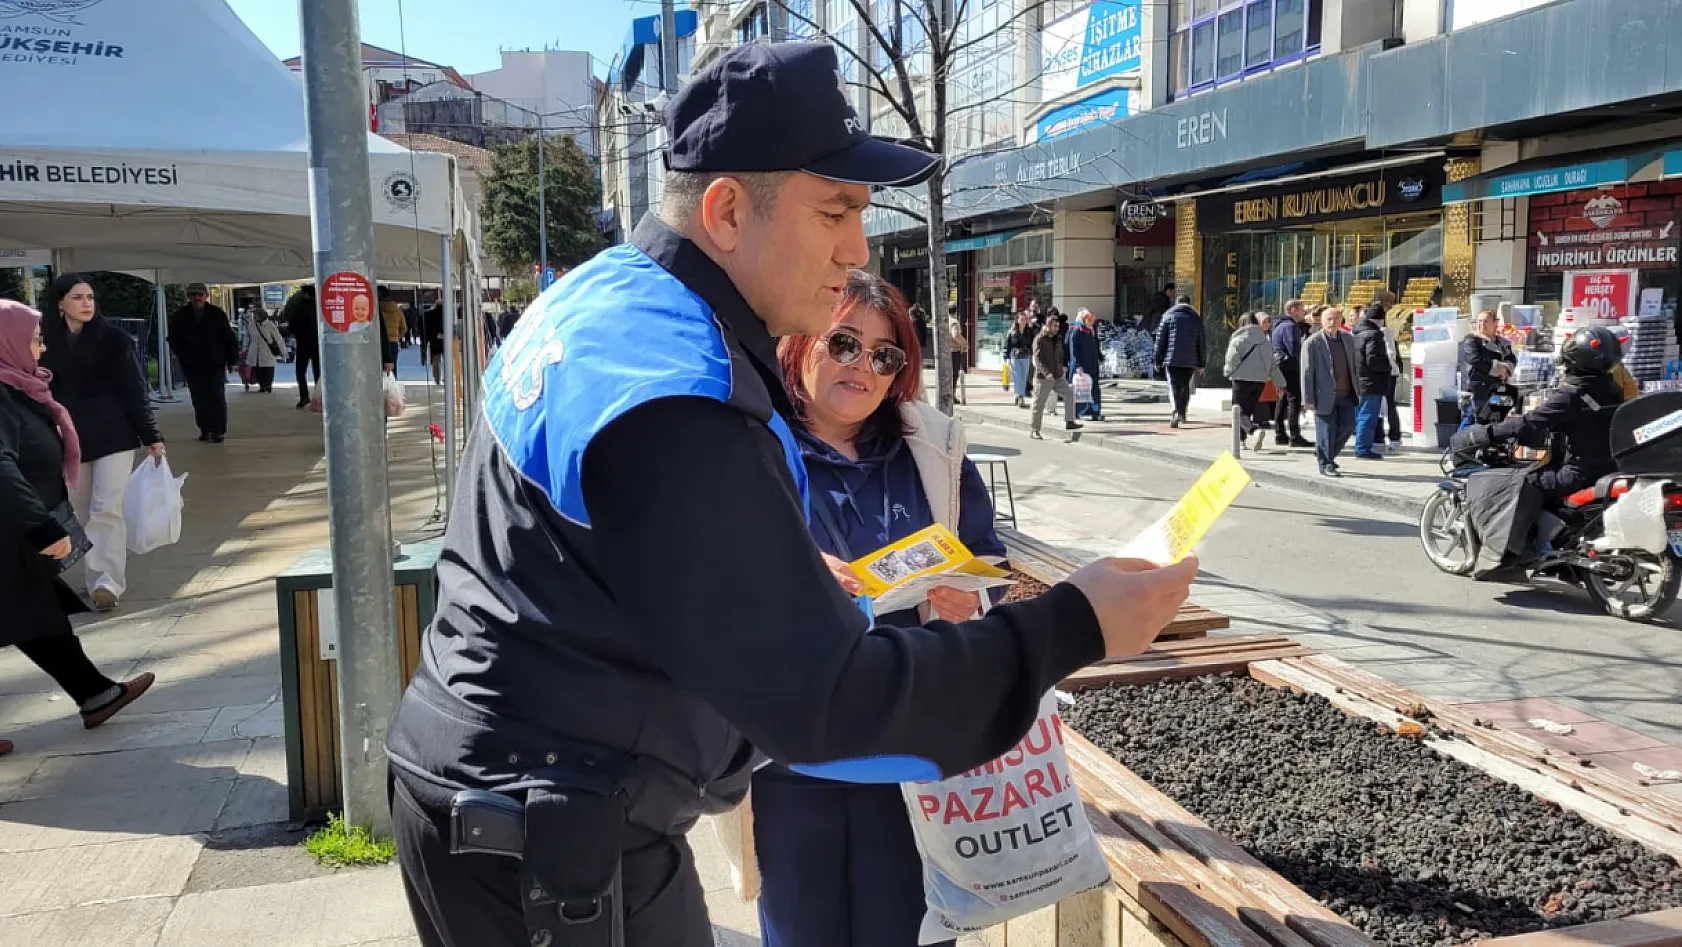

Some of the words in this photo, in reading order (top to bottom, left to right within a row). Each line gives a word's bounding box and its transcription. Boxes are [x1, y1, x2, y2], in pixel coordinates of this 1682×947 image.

[1090, 6, 1138, 47] İŞİTME
[1177, 107, 1228, 149] EREN
[46, 163, 178, 186] BELEDİYESİ
[1127, 204, 1154, 216] EREN
[1234, 196, 1278, 225] EREN
[1282, 181, 1386, 219] KUYUMCU
[1536, 247, 1602, 267] İNDİRİMLİ
[1605, 244, 1678, 264] ÜRÜNLER
[954, 802, 1074, 860] OUTLET
